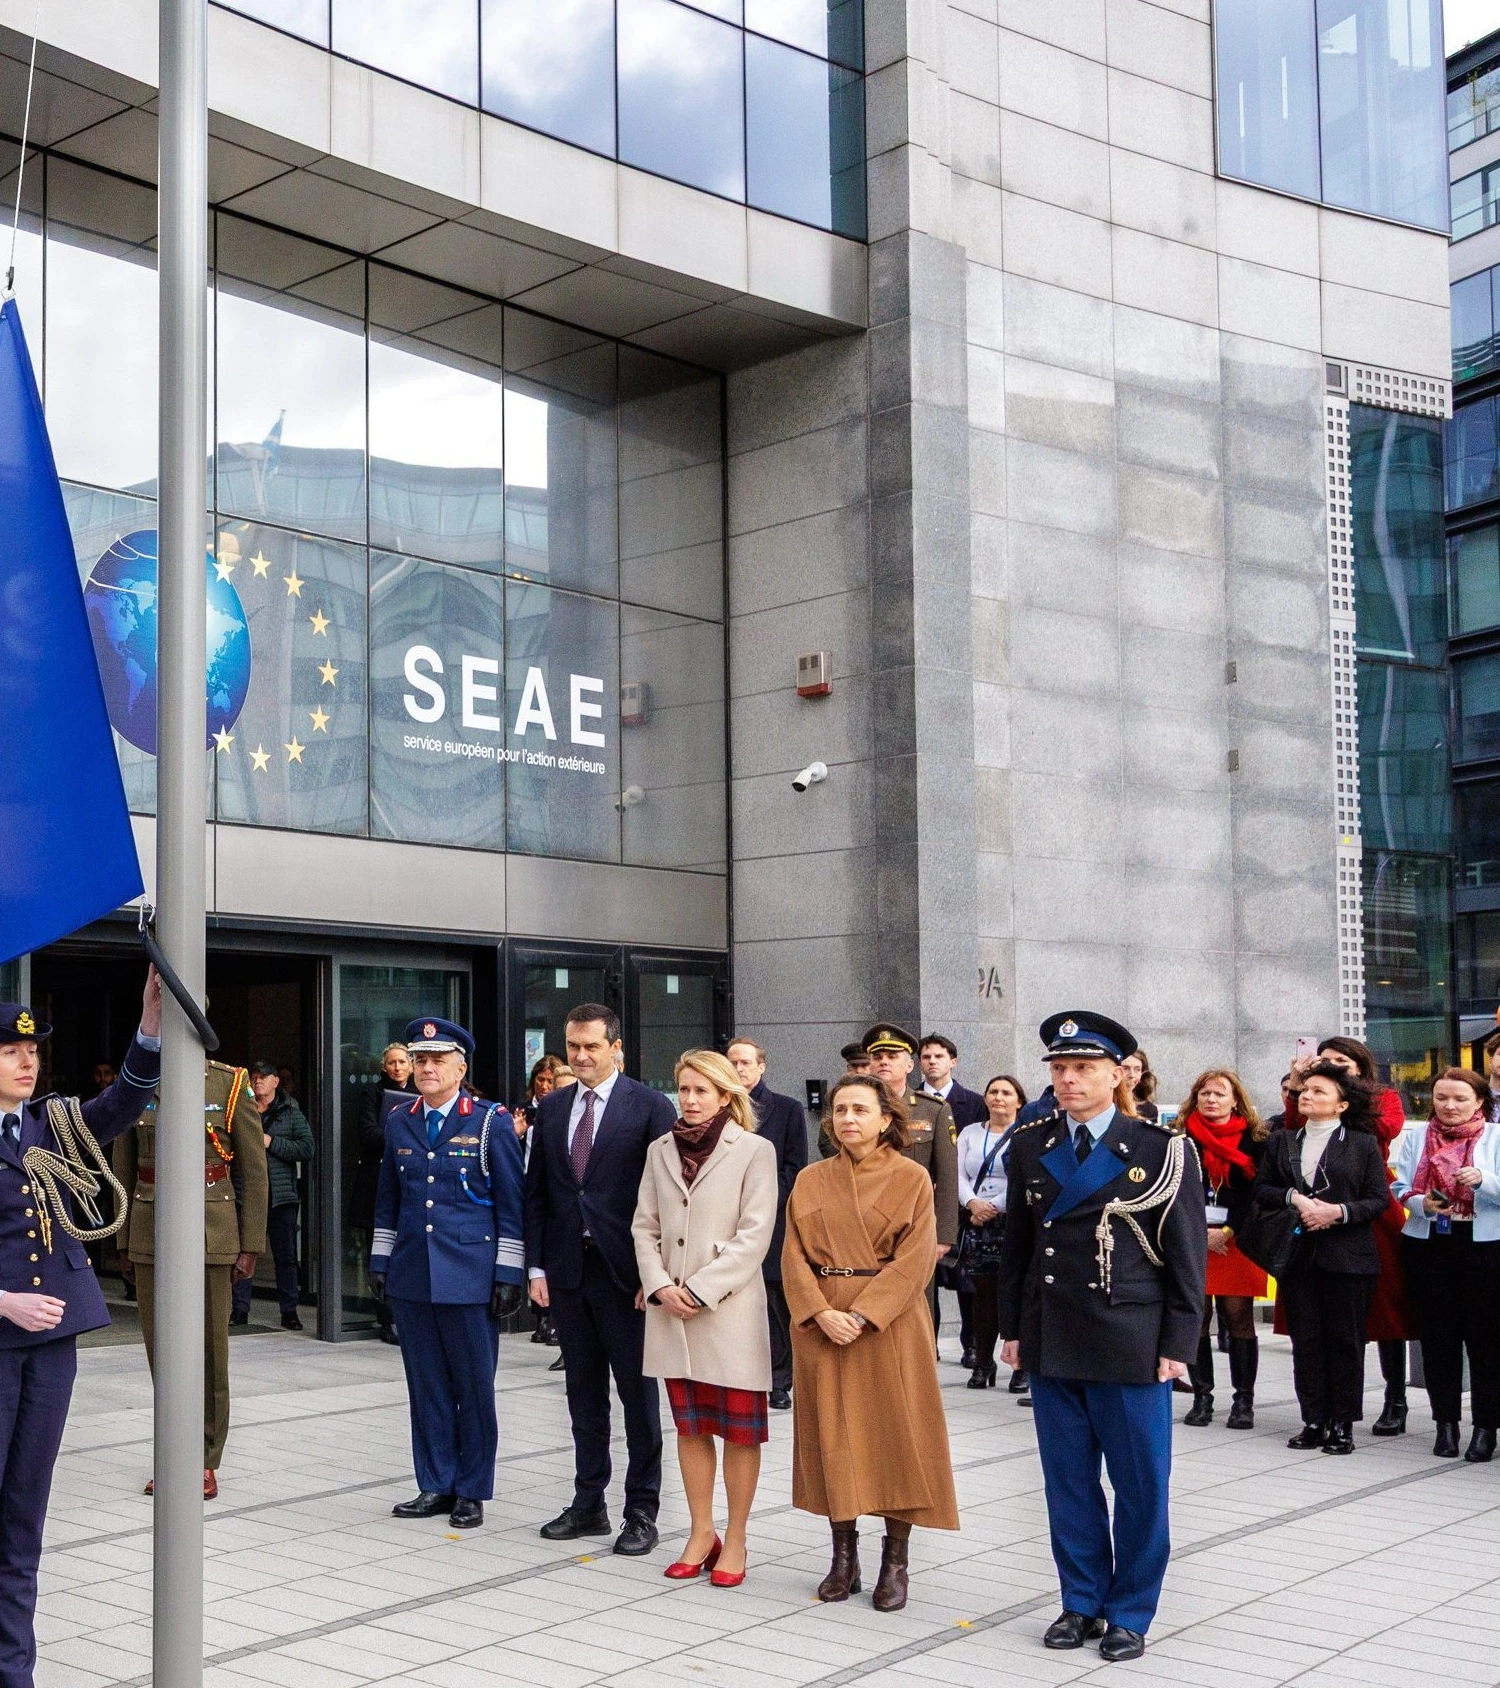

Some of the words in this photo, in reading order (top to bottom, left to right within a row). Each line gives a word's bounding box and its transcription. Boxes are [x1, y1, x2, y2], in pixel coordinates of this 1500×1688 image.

[403, 645, 606, 748] SEAE
[403, 735, 442, 752] service
[444, 742, 495, 760] européen
[497, 749, 521, 763] pour
[557, 757, 606, 775] extérieure
